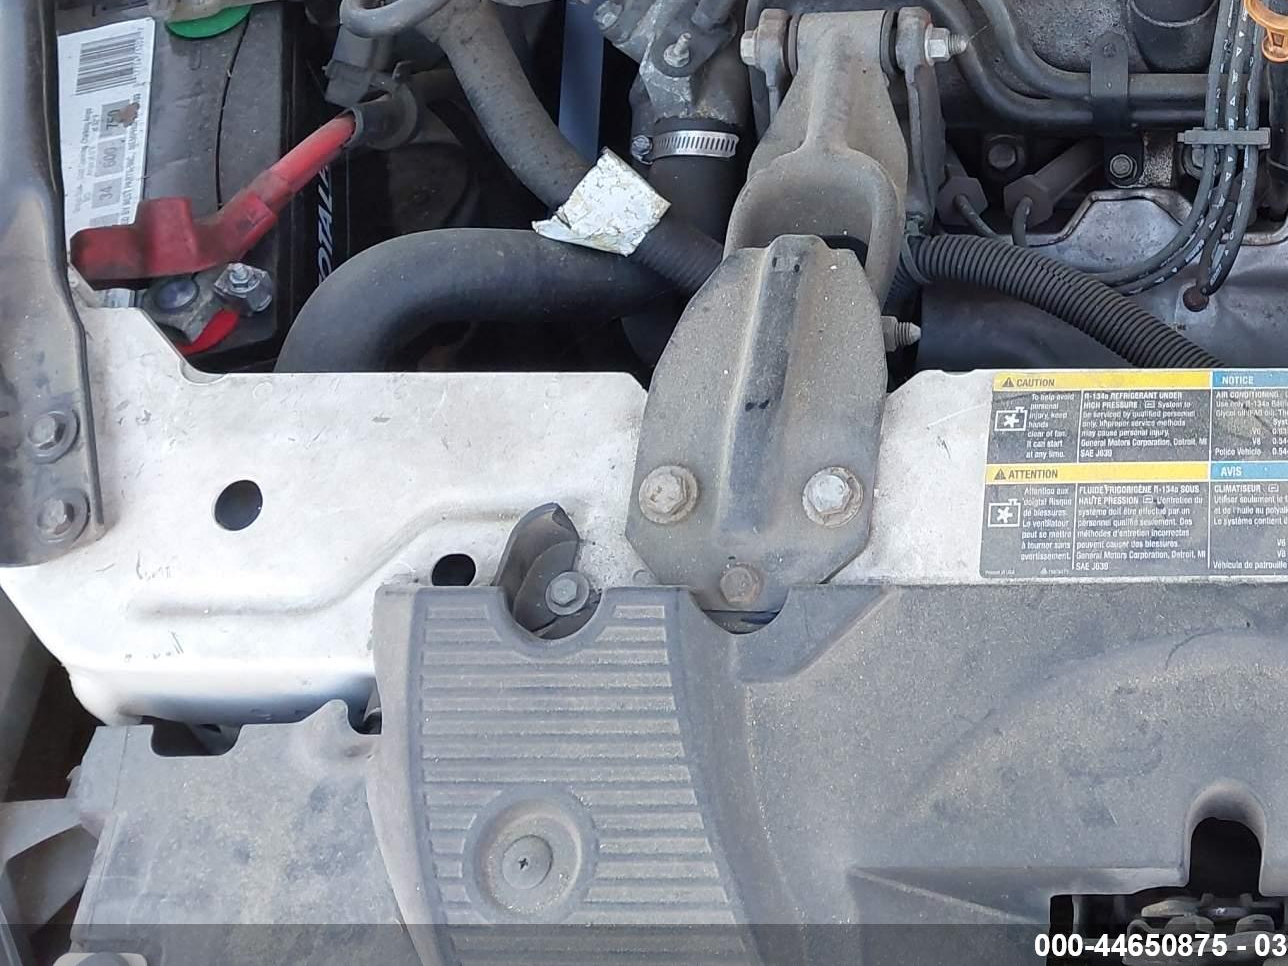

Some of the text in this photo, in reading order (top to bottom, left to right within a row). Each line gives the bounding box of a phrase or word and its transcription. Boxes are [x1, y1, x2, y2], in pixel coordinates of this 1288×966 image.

[99, 186, 113, 201] 34
[1016, 379, 1055, 387] CAUTION
[1222, 376, 1254, 385] NOTICE
[1159, 392, 1182, 400] UNDER
[1216, 391, 1228, 399] AIR
[1083, 401, 1101, 409] HIGH
[1102, 401, 1138, 409] PRESSURE
[1122, 411, 1131, 419] by
[1081, 439, 1106, 447] General
[1107, 439, 1131, 447] Motors
[1199, 438, 1208, 446] MI
[1034, 452, 1047, 460] any
[1080, 449, 1113, 458] SAE J639
[1215, 448, 1236, 457] Police
[1237, 447, 1262, 456] Vehicle
[1008, 469, 1058, 479] ATTENTION
[1221, 466, 1242, 477] AVIS
[1024, 487, 1054, 495] Attention
[1079, 485, 1200, 494] FLUIDE R-134a SOUS
[1214, 484, 1261, 493] CLIMATISEUR
[1079, 496, 1139, 505] HAUTE PRESSION
[1023, 509, 1032, 517] de
[1168, 508, 1180, 516] par
[1255, 507, 1264, 515] au
[1023, 520, 1032, 528] Le
[1179, 517, 1193, 526] Des
[1213, 517, 1222, 525] Le
[1022, 531, 1037, 540] peut
[1103, 550, 1128, 559] Motors
[1197, 550, 1206, 559] MI
[1076, 562, 1090, 571] SAE
[1244, 560, 1253, 569] de
[1254, 560, 1288, 570] patrouille
